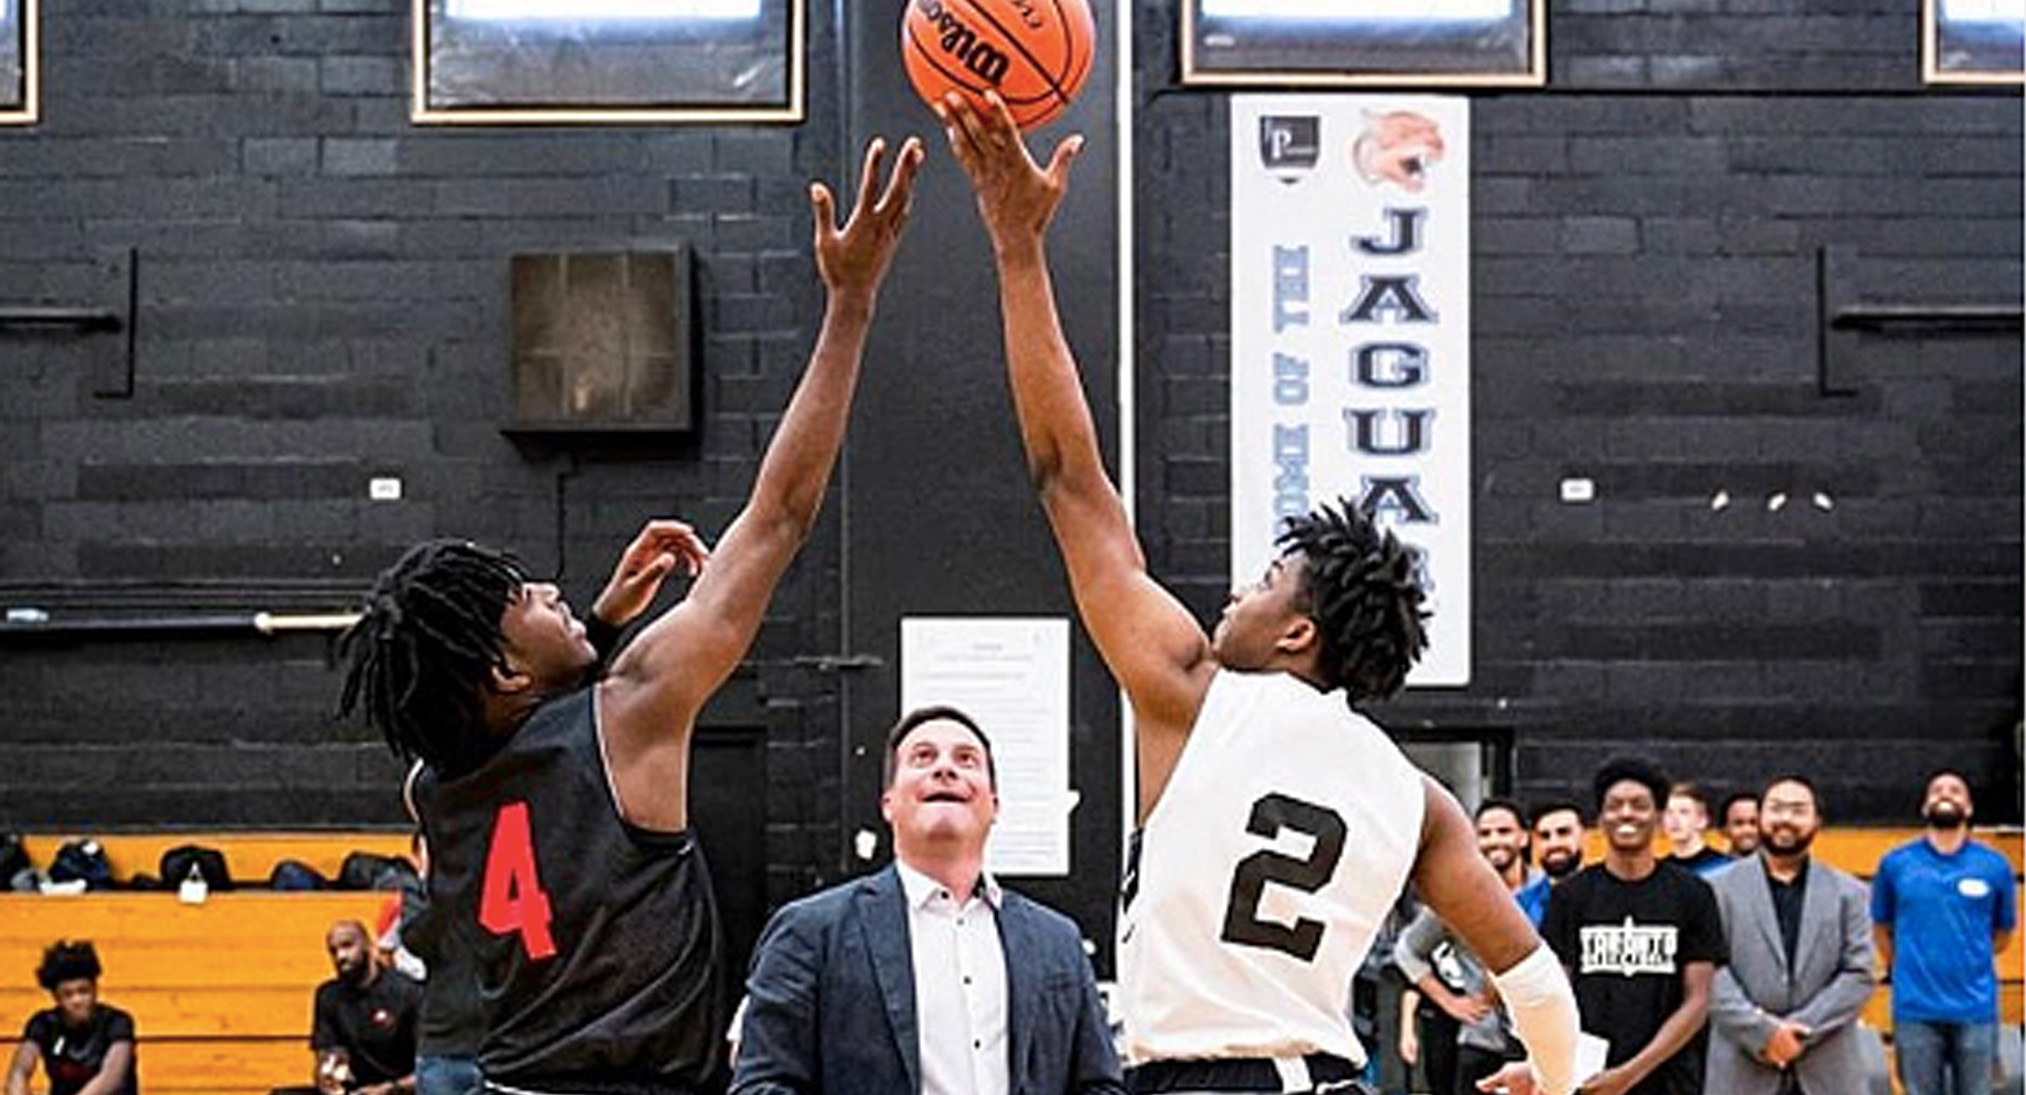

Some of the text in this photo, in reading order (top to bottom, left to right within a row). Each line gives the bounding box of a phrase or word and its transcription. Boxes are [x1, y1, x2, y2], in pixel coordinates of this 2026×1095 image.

[1273, 244, 1310, 334] THE
[1273, 352, 1310, 405] OF
[479, 801, 558, 960] 4
[1219, 792, 1348, 962] 2
